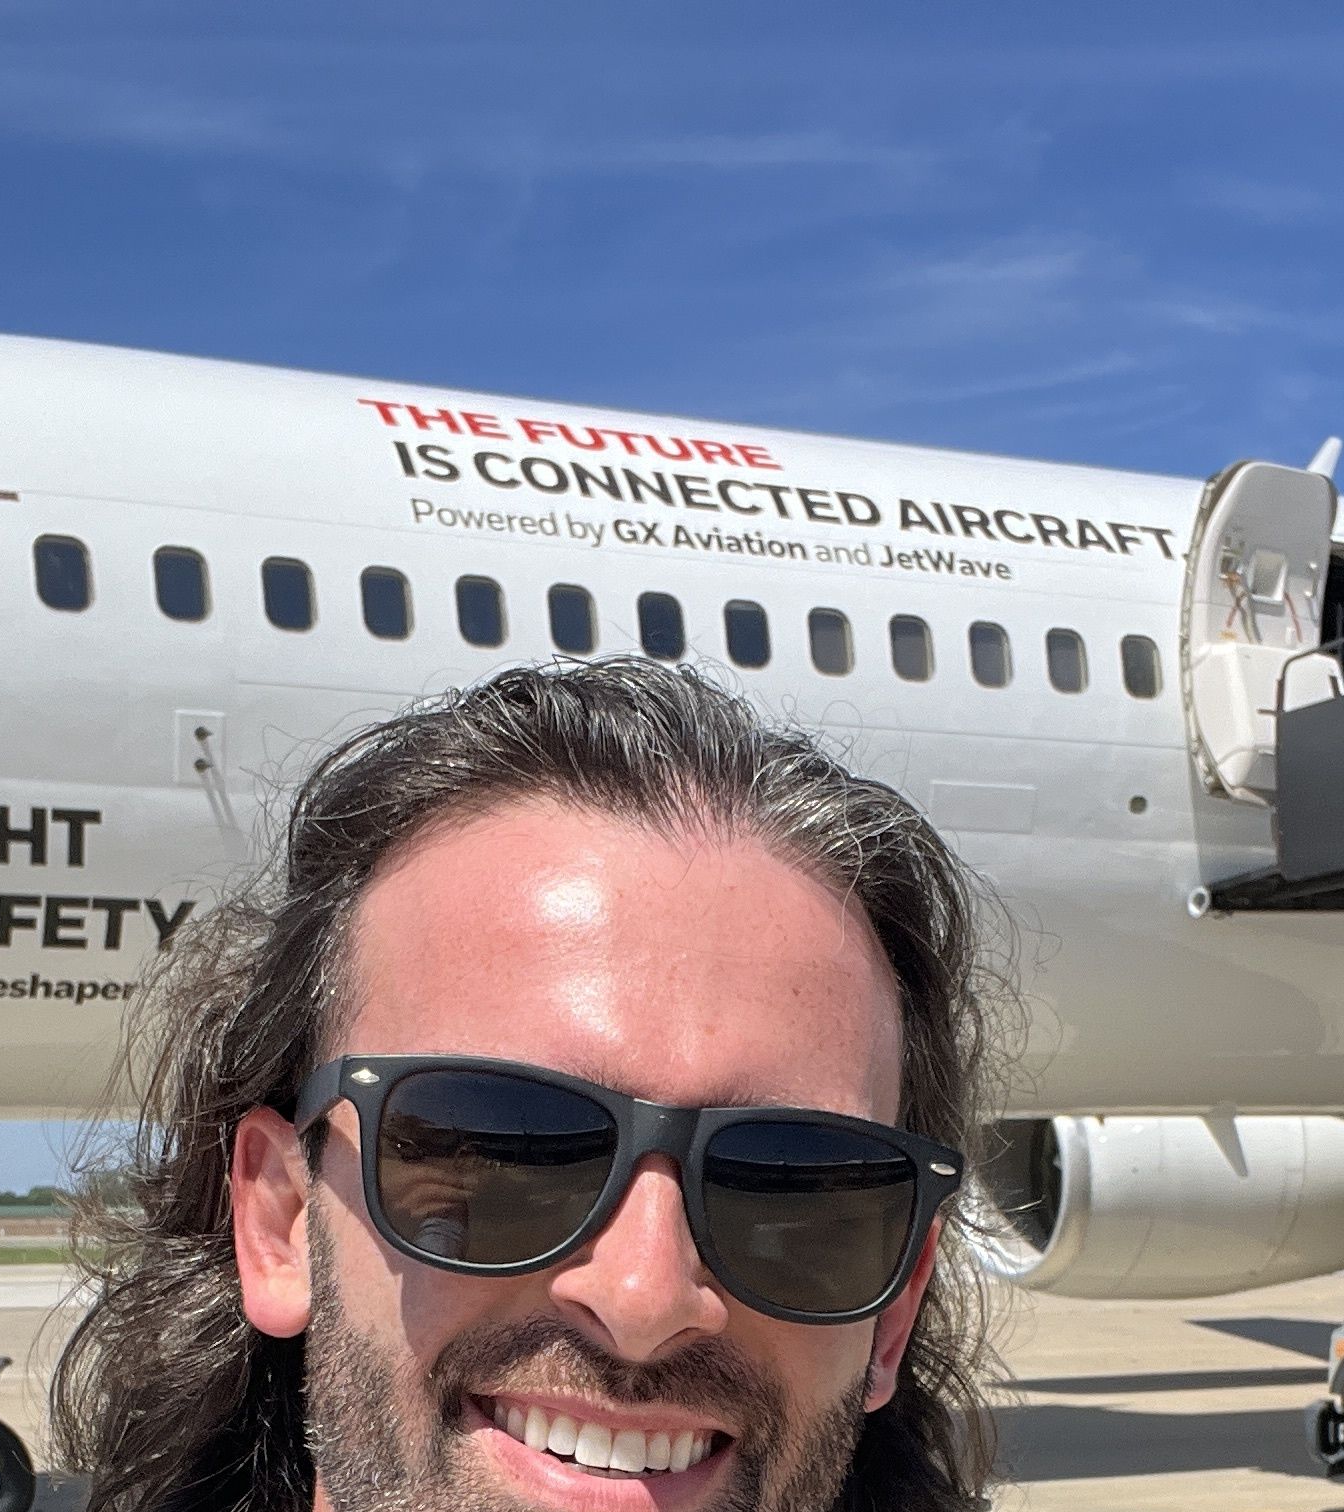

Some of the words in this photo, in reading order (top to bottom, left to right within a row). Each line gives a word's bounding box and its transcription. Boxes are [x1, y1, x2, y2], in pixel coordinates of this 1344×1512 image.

[358, 399, 509, 441] THE
[516, 418, 782, 470] FUTURE
[393, 440, 461, 482] IS
[472, 451, 881, 525] CONNECTED
[898, 498, 1175, 561] AIRCRAFT
[410, 498, 558, 536] Powered
[567, 513, 605, 548] by
[613, 518, 664, 547] GX
[672, 524, 808, 561] Aviation
[815, 541, 873, 567] and
[879, 544, 1013, 580] JetWave
